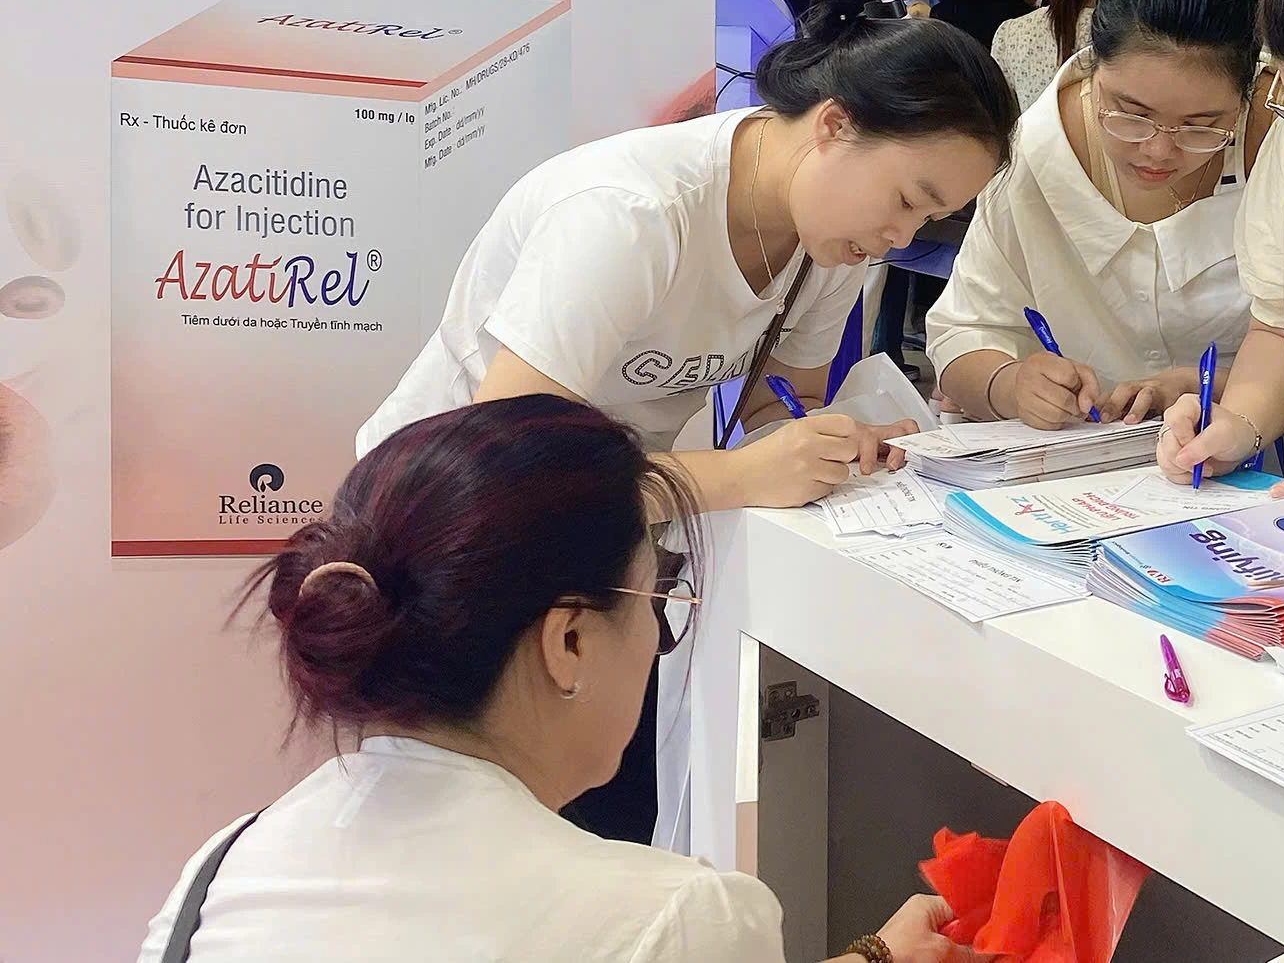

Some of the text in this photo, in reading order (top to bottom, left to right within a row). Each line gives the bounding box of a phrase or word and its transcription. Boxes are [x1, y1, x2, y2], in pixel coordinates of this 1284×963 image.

[120, 113, 139, 128] Rx
[152, 114, 196, 132] Thuốc
[200, 117, 216, 133] kê
[220, 120, 247, 136] đơn
[355, 109, 375, 121] 100
[378, 112, 395, 124] mg
[405, 111, 415, 126] lọ
[424, 116, 441, 134] Batch
[193, 164, 347, 200] Azacitidine
[184, 202, 355, 238] for Injection
[181, 314, 383, 333] Tiêm dưới da hoặc Truyền tĩnh mạch
[219, 495, 323, 514] Reliance
[219, 515, 249, 525] Life
